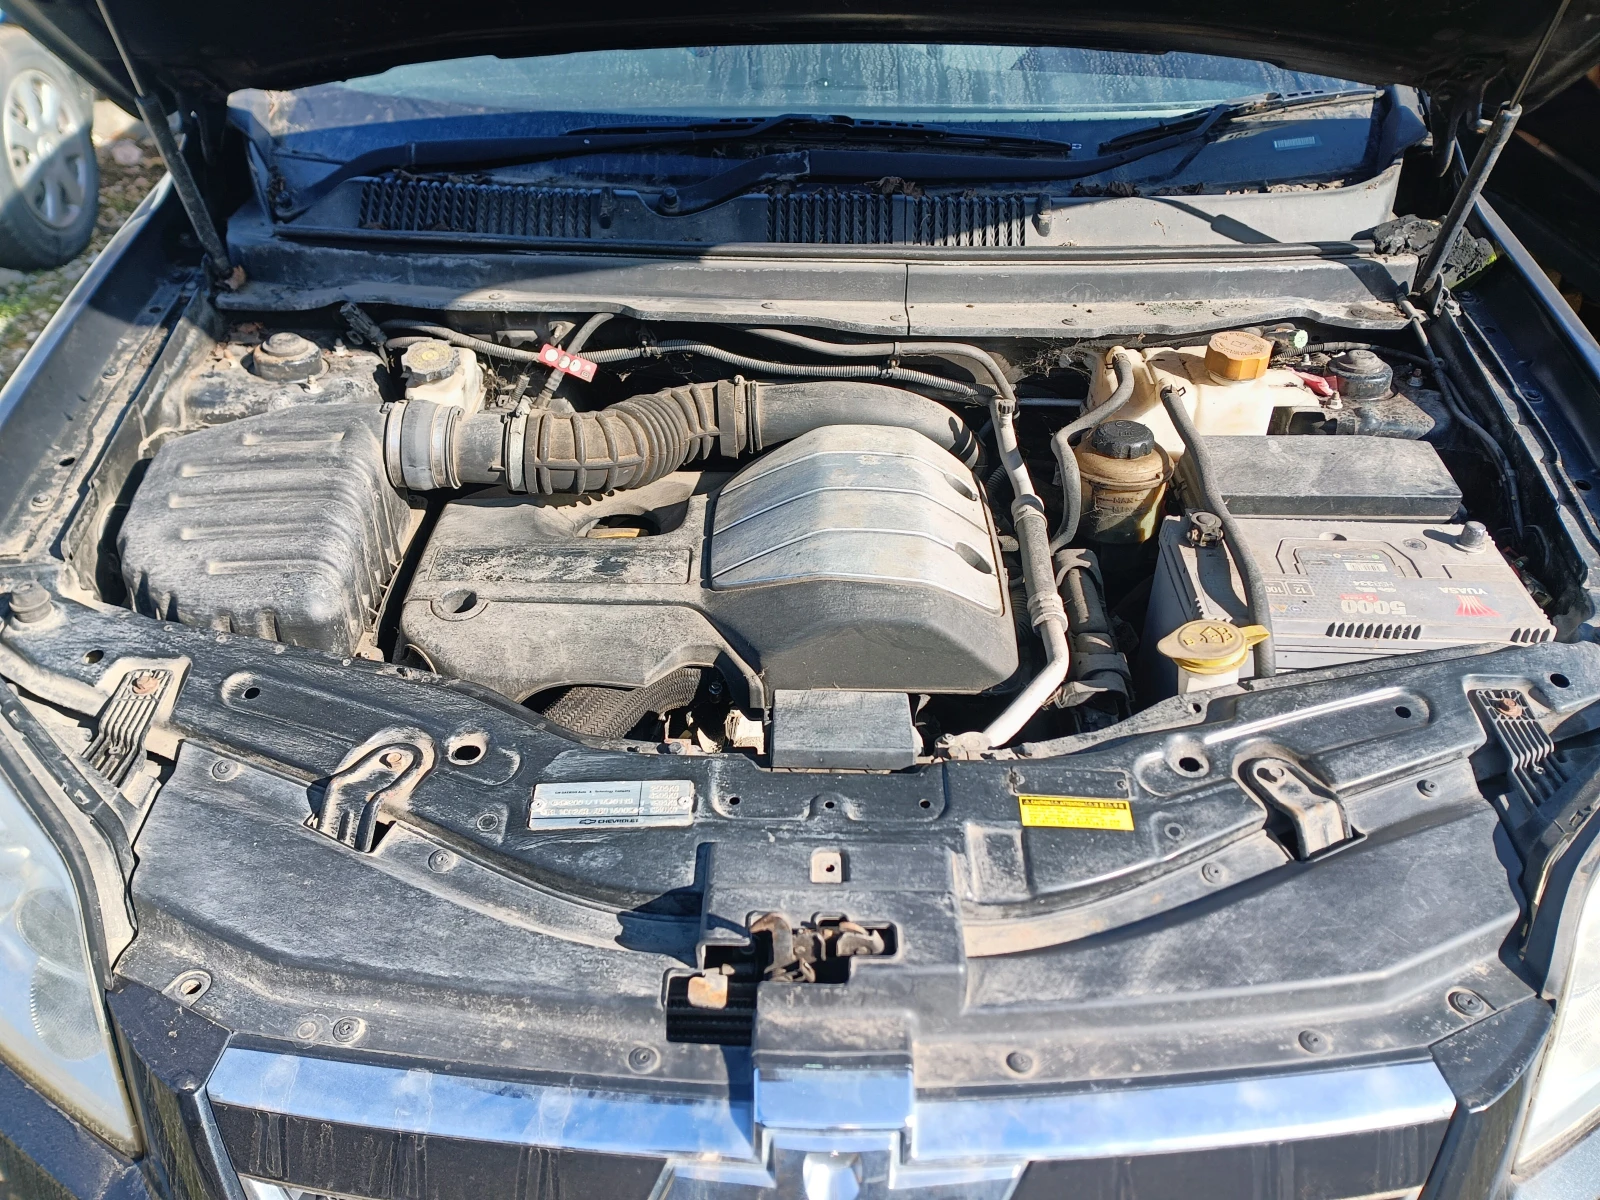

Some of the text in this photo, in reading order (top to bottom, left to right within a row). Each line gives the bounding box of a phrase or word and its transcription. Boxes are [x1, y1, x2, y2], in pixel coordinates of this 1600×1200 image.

[1293, 586, 1308, 594] 12
[1437, 587, 1488, 595] YUASA
[1341, 600, 1406, 615] 5000
